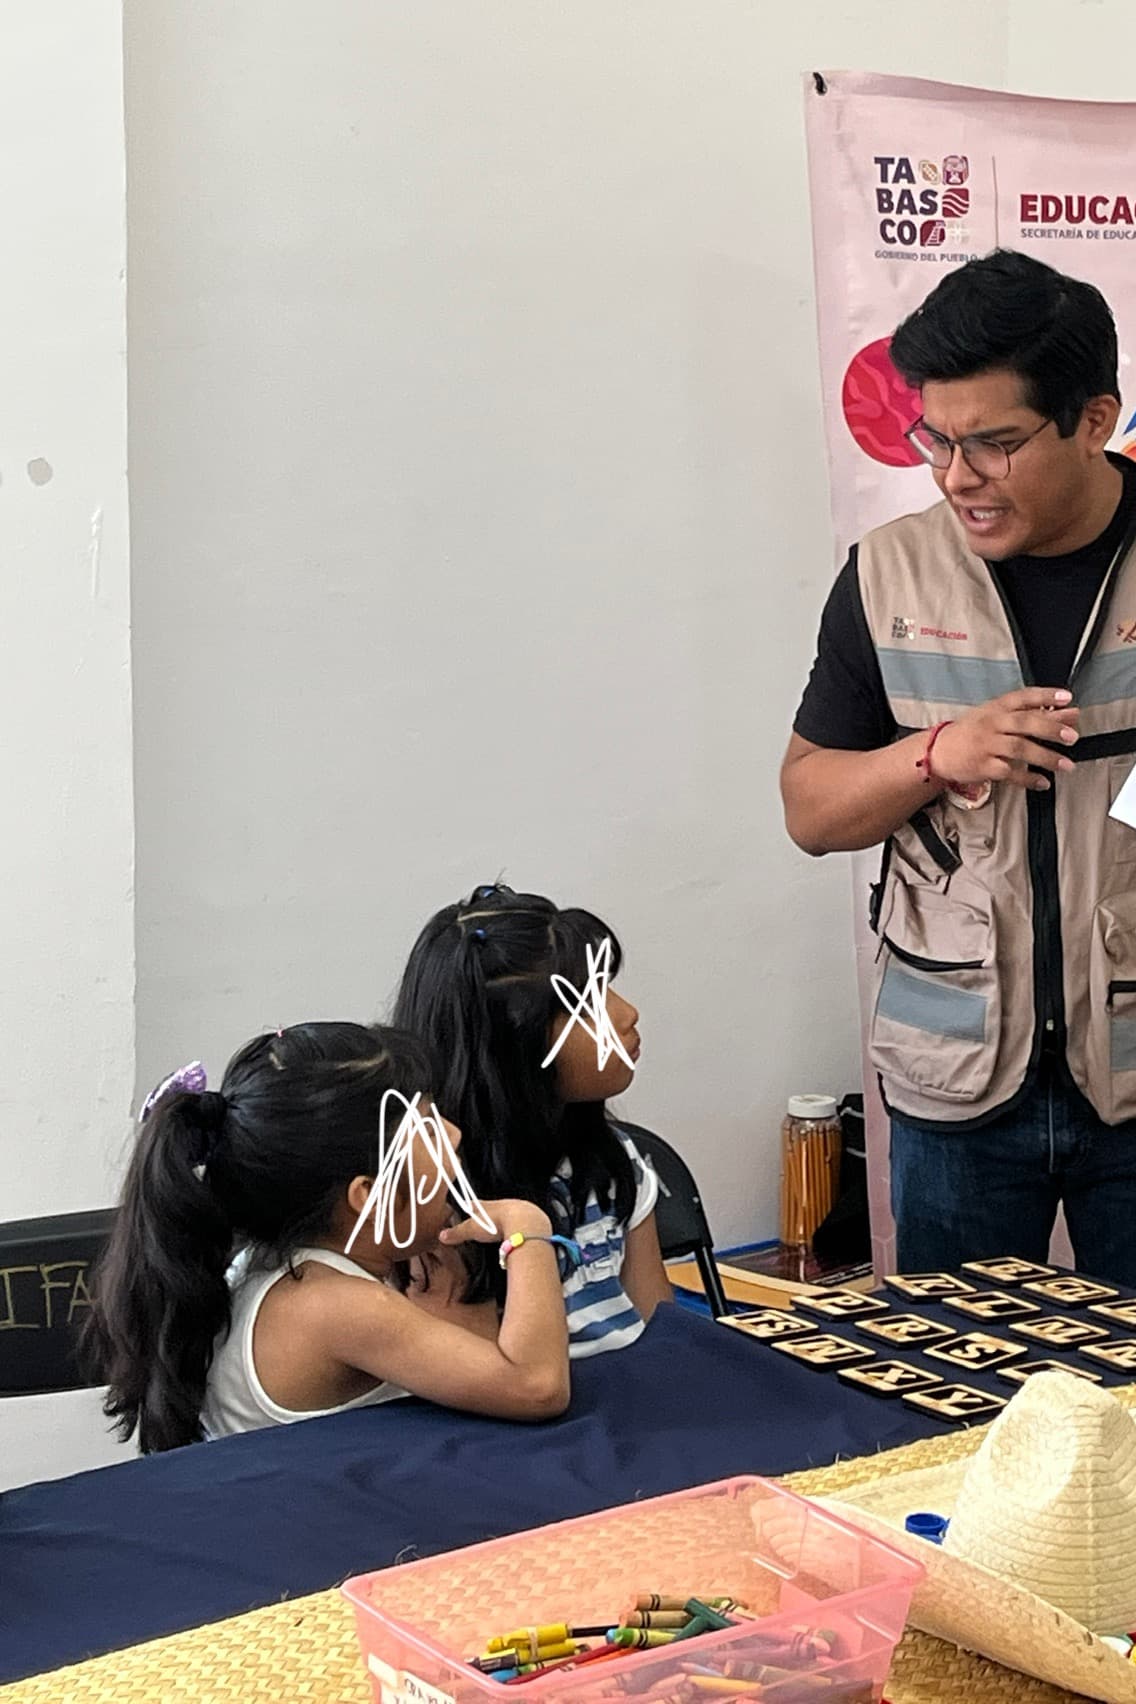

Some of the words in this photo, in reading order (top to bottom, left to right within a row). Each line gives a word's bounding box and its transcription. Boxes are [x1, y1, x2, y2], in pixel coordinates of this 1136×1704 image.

[874, 156, 916, 184] TA
[876, 188, 938, 216] BAS
[880, 218, 918, 246] CO
[1020, 227, 1083, 240] SECRETARÍA
[1086, 229, 1100, 240] DE
